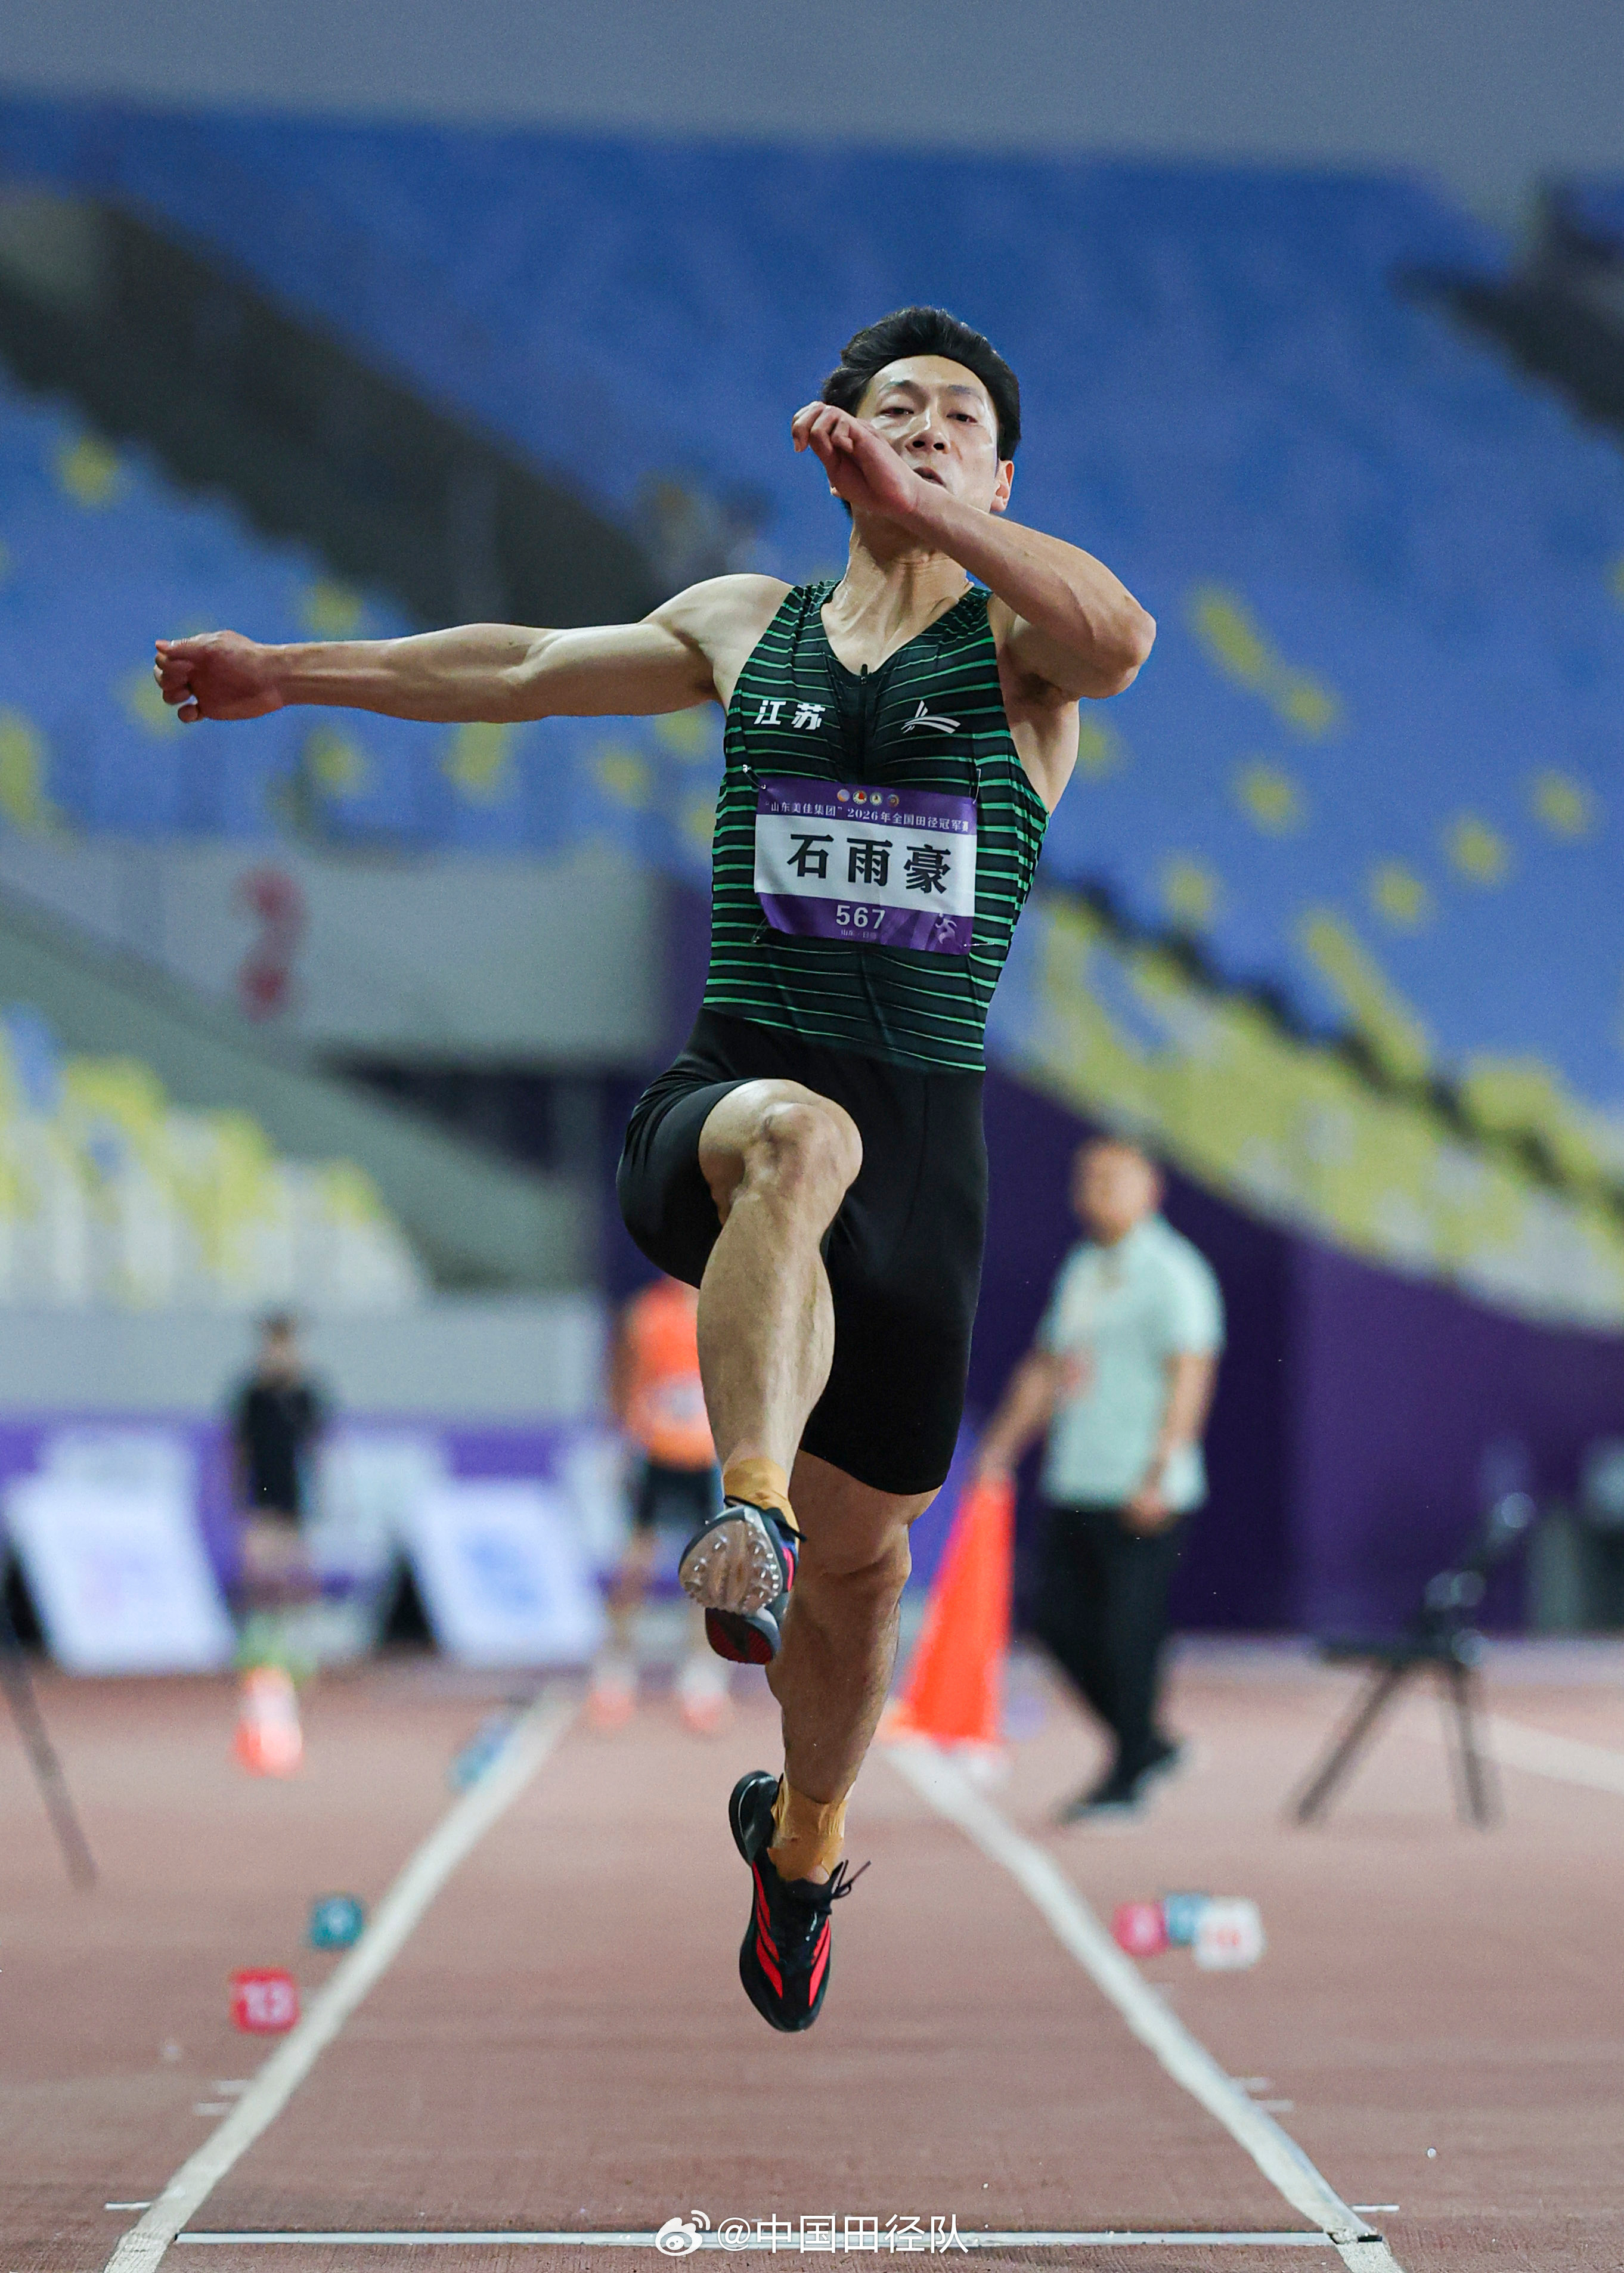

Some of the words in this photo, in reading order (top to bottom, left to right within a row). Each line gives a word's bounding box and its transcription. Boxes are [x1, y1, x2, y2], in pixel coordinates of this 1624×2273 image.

[754, 699, 826, 730] 江苏
[786, 833, 952, 894] 石雨豪
[836, 904, 886, 929] 567
